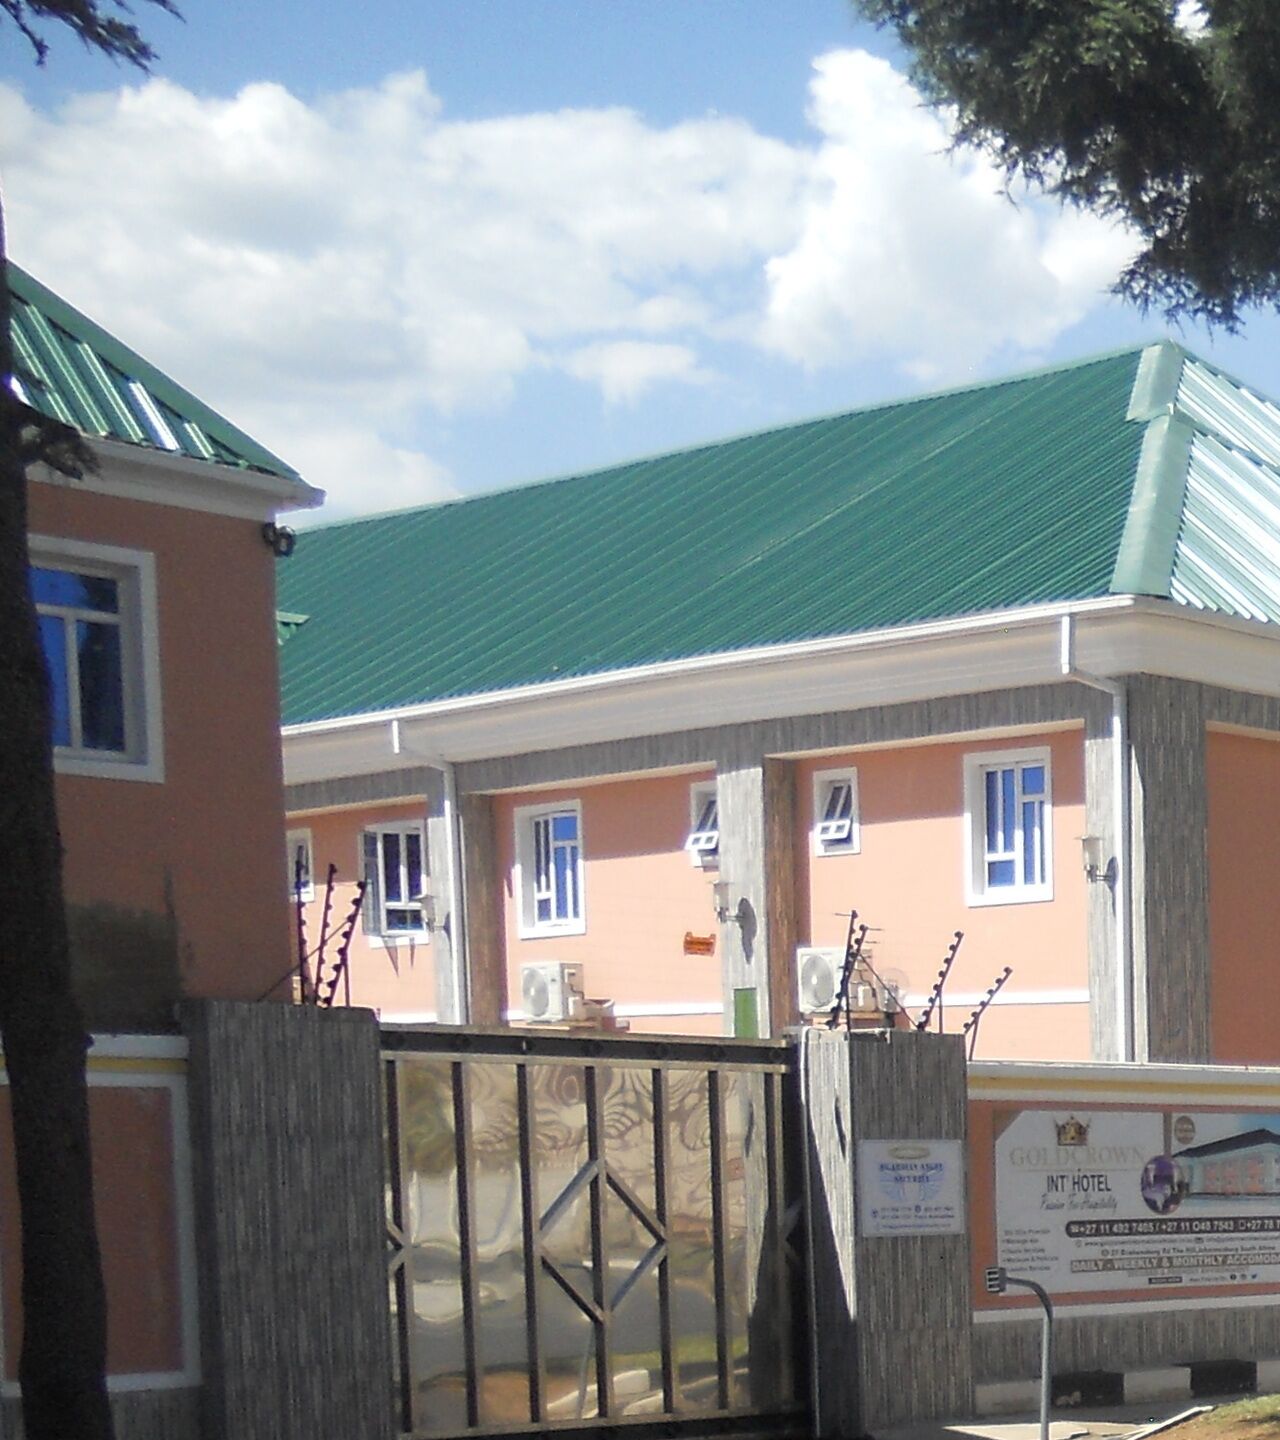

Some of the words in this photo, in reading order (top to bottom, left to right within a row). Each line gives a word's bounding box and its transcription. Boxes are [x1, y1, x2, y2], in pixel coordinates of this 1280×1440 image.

[1009, 1145, 1145, 1166] GOLDCROWN
[1072, 1174, 1112, 1192] HOTEL
[1100, 1224, 1110, 1234] 11
[1180, 1221, 1190, 1232] 11
[1172, 1254, 1224, 1268] MONTHLY
